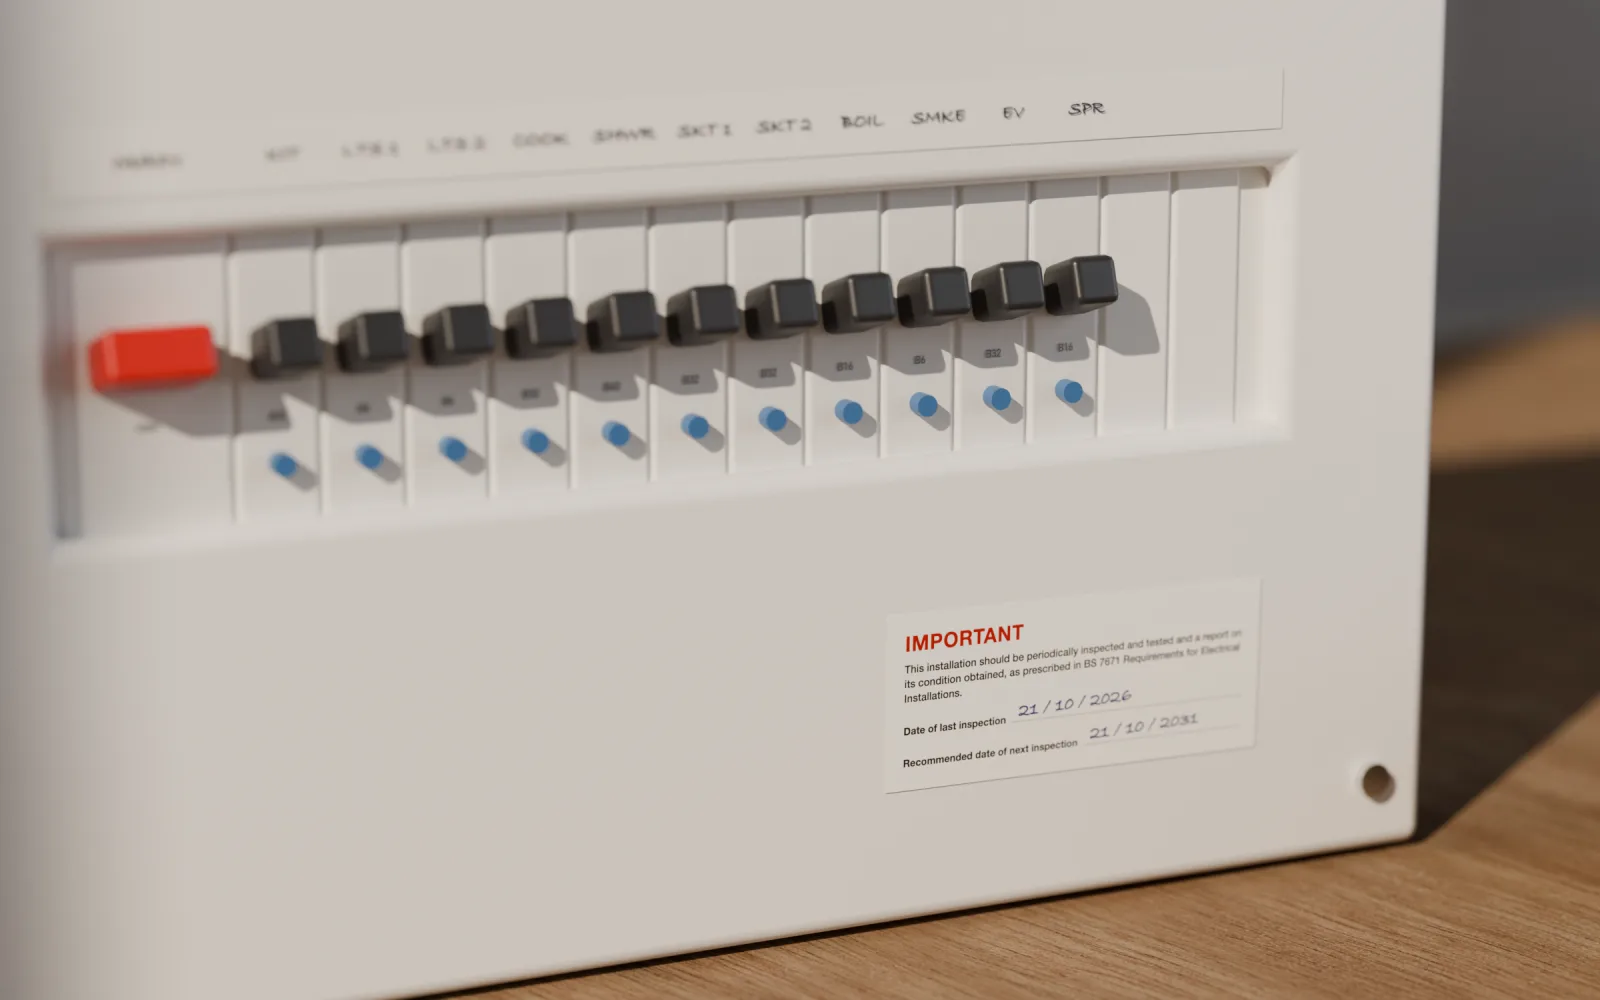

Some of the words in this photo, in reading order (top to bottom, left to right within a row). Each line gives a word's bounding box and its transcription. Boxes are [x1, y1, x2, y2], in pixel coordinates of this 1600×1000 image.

[1003, 107, 1024, 119] EV
[1068, 103, 1105, 115] SPR
[841, 115, 884, 129] BOIL
[912, 110, 964, 124] SMKE
[679, 124, 718, 138] SKT
[757, 119, 796, 134] SKT
[800, 118, 812, 131] 2
[985, 348, 1002, 359] B32
[1057, 341, 1074, 353] B16
[836, 361, 854, 373] B16
[914, 354, 927, 366] B6
[905, 624, 1024, 652] IMPORTANT
[904, 665, 924, 674] This
[926, 660, 976, 671] installation
[979, 654, 1010, 666] should
[1012, 654, 1024, 662] be
[1026, 648, 1078, 662] periodically
[1080, 642, 1124, 654] inspected
[1126, 640, 1144, 649] and
[1145, 637, 1174, 647] tested
[1175, 635, 1193, 644] and
[1201, 631, 1229, 641] report
[904, 680, 915, 688] its
[917, 676, 961, 687] condition
[963, 669, 1006, 682] obtained,
[1009, 669, 1020, 677] as
[1022, 662, 1071, 677] prescribed
[1072, 661, 1081, 669] in
[1083, 658, 1097, 668] BS
[1099, 656, 1119, 666] 7671
[1122, 650, 1184, 663] Requirements
[1185, 648, 1199, 656] for
[1200, 644, 1240, 655] Electrical
[904, 691, 962, 703] Installations.
[1018, 704, 1038, 716] 21
[1055, 699, 1074, 711] 10
[1089, 690, 1132, 706] 2026
[903, 727, 925, 736] Date
[927, 724, 937, 733] of
[939, 722, 956, 731] last
[958, 717, 1006, 729] inspection
[1089, 727, 1109, 739] 21
[1125, 721, 1144, 734] 10
[1159, 714, 1198, 728] 2031
[903, 752, 972, 767] Recommended
[975, 750, 995, 758] date
[997, 748, 1007, 756] of
[1009, 745, 1028, 754] next
[1031, 740, 1077, 752] inspection
